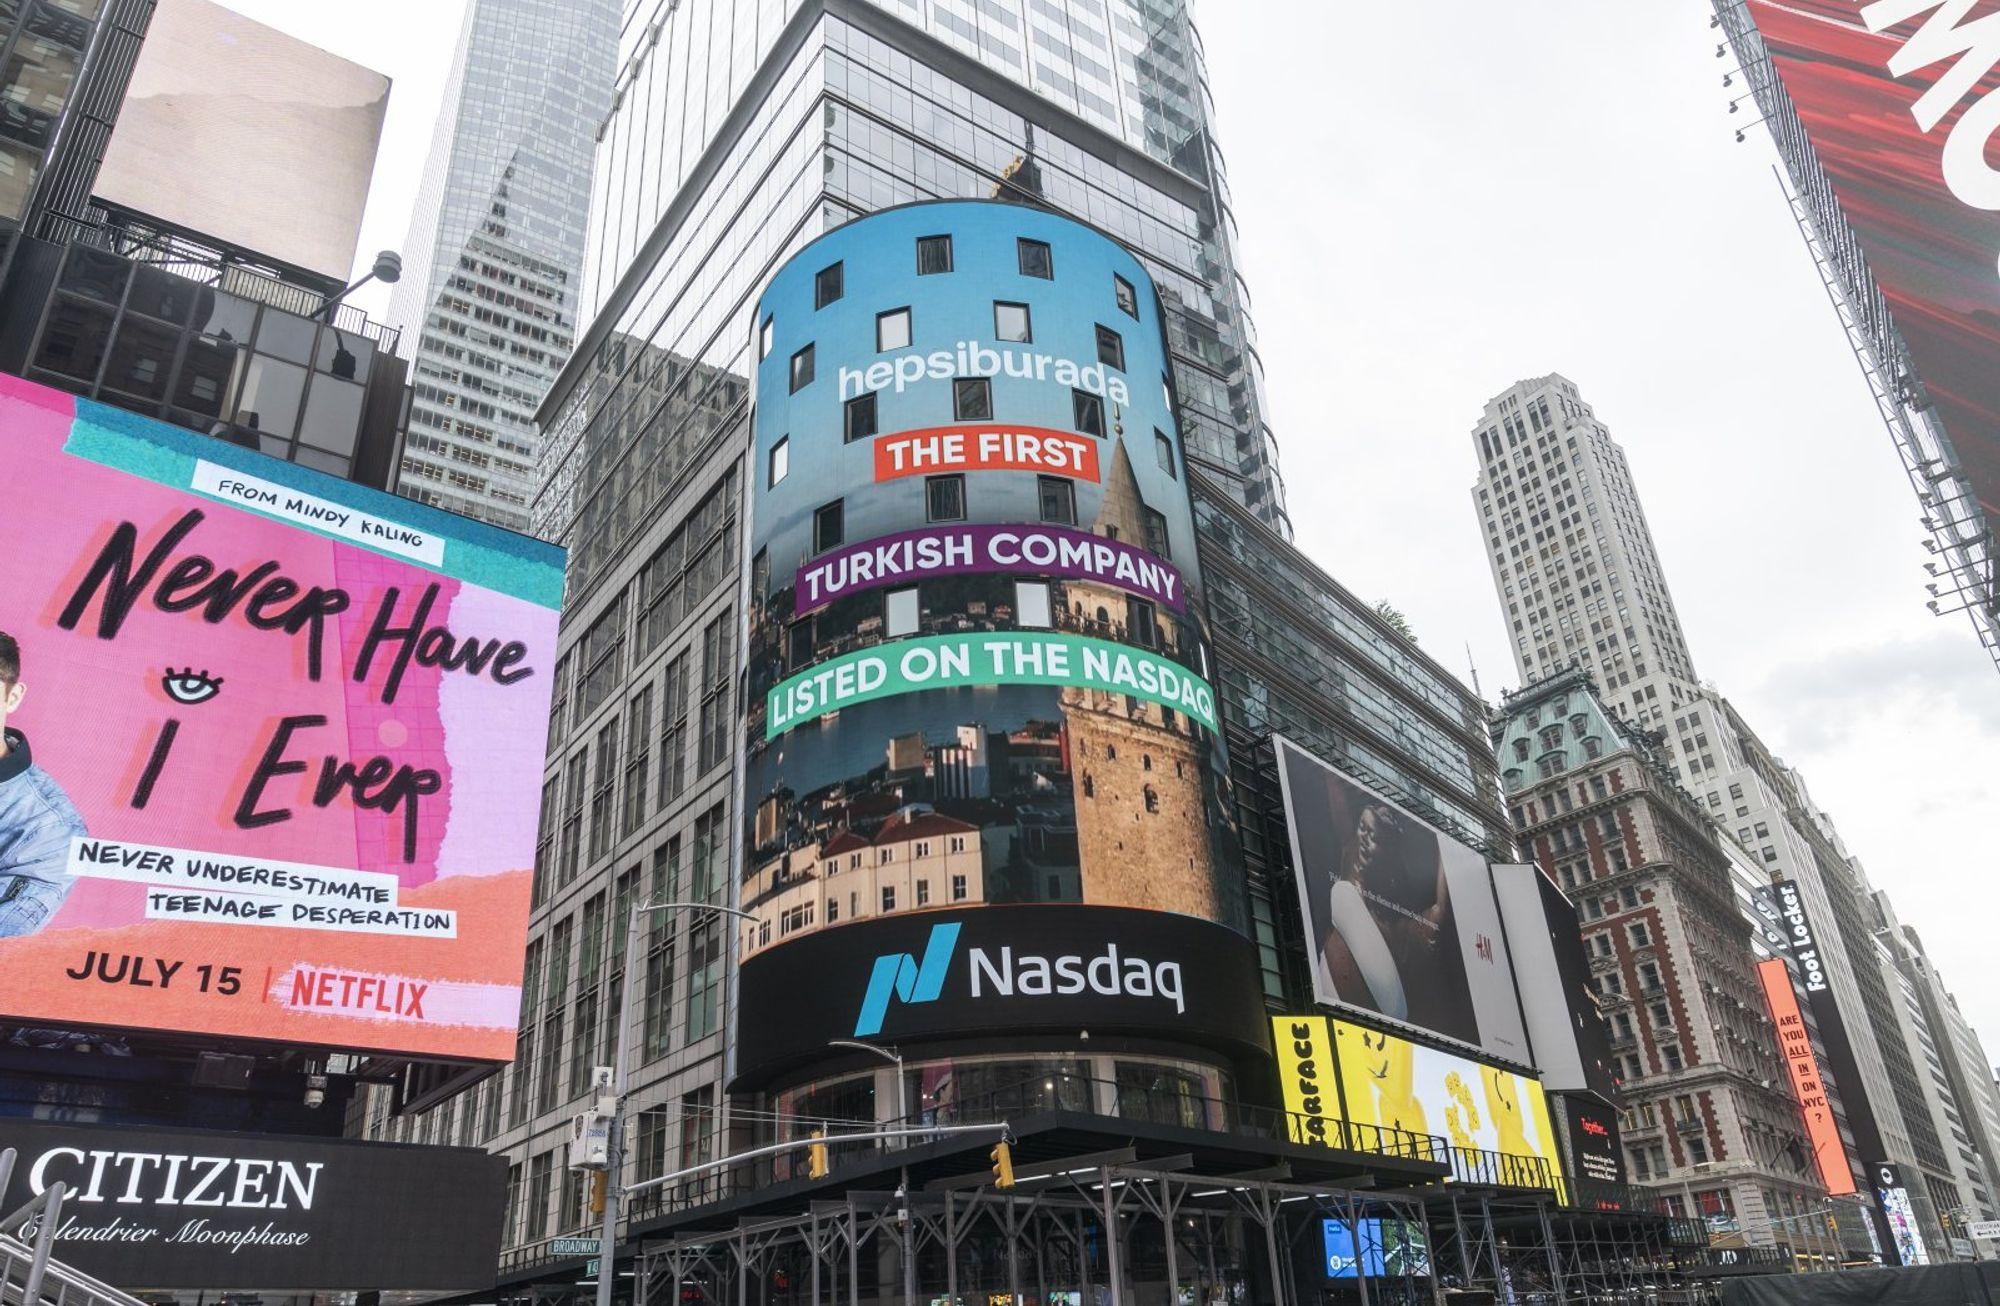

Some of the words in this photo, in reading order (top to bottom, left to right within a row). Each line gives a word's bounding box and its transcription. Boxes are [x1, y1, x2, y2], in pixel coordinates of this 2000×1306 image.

[838, 341, 1130, 407] hepsiburada
[886, 435, 966, 471] THE
[978, 433, 1087, 471] FIRST
[219, 479, 278, 505] FROM
[286, 498, 350, 528] MINDY
[361, 520, 423, 547] KALING
[804, 535, 973, 602] TURKISH
[987, 533, 1176, 600] COMPANY
[57, 508, 351, 681] Never
[352, 582, 535, 704] Have
[772, 656, 887, 729] LISTED
[900, 642, 970, 683] ON
[984, 642, 1070, 678] THE
[1083, 645, 1215, 726] NASDAQ
[131, 719, 180, 810] I
[233, 714, 442, 864] Ever
[79, 841, 174, 875] NEVER
[187, 859, 390, 904] UNDERESTIMATE
[149, 893, 283, 919] TEENAGE
[292, 903, 450, 930] DESPERATION
[1780, 885, 1811, 947] Locker
[66, 950, 183, 988] JULY
[196, 964, 242, 996] 15
[290, 969, 429, 1019] NETFLIX
[968, 942, 1185, 1015] Nasdaq
[1797, 950, 1826, 991] Foot
[1779, 1015, 1799, 1026] ARE
[1783, 1030, 1804, 1041] YOU
[1789, 1045, 1809, 1057] ALL
[1798, 1063, 1809, 1073] IN
[1802, 1082, 1817, 1092] ON
[1803, 1096, 1825, 1108] NYC
[1815, 1112, 1822, 1123] ?
[29, 1146, 324, 1210] CITIZEN
[18, 1213, 160, 1243] Clendrier
[165, 1219, 312, 1254] Moonphase
[553, 1240, 598, 1253] BROADWAY
